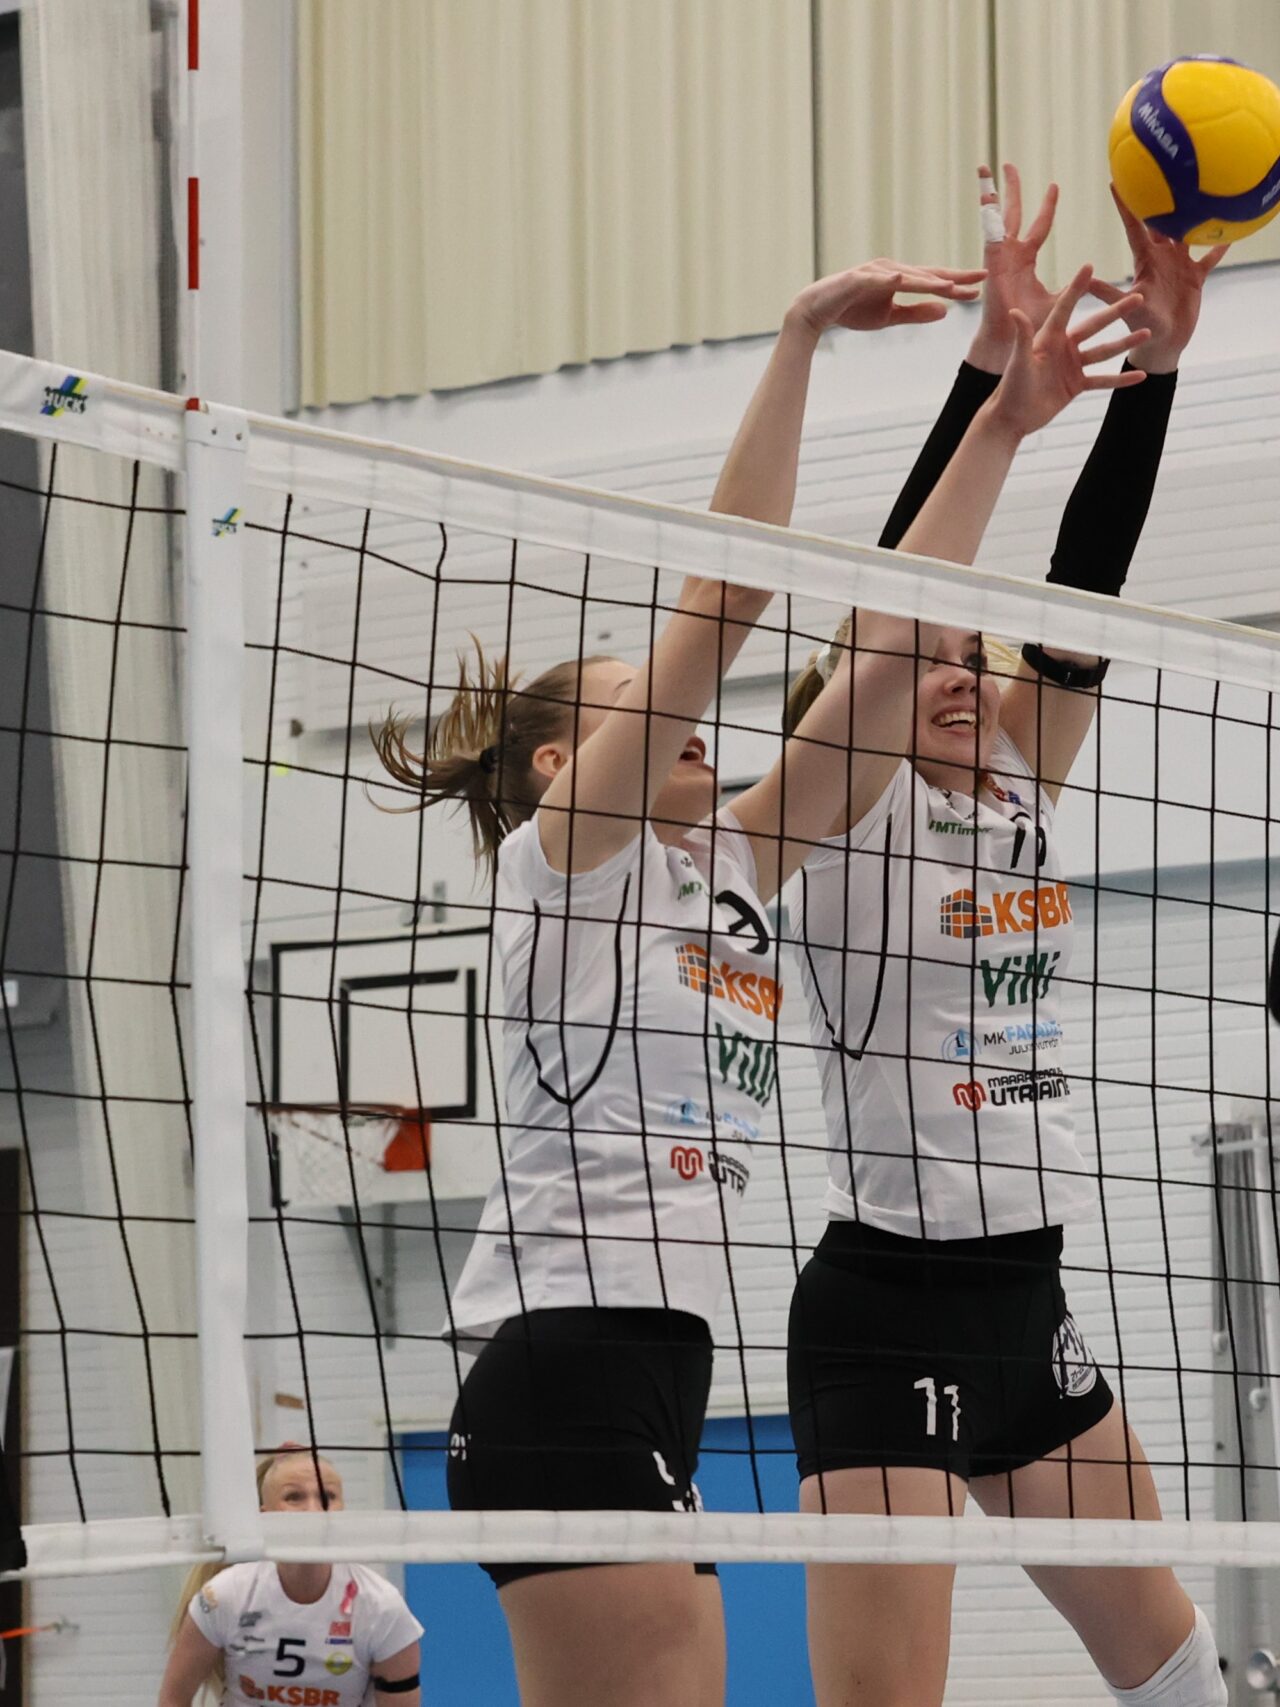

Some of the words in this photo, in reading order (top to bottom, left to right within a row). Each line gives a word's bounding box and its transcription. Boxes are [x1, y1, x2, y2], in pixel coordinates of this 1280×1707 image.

[720, 961, 784, 1020] KSB
[990, 1077, 1070, 1106] UTRIAIN
[273, 1637, 307, 1677] 5
[267, 1684, 341, 1707] KSBR
